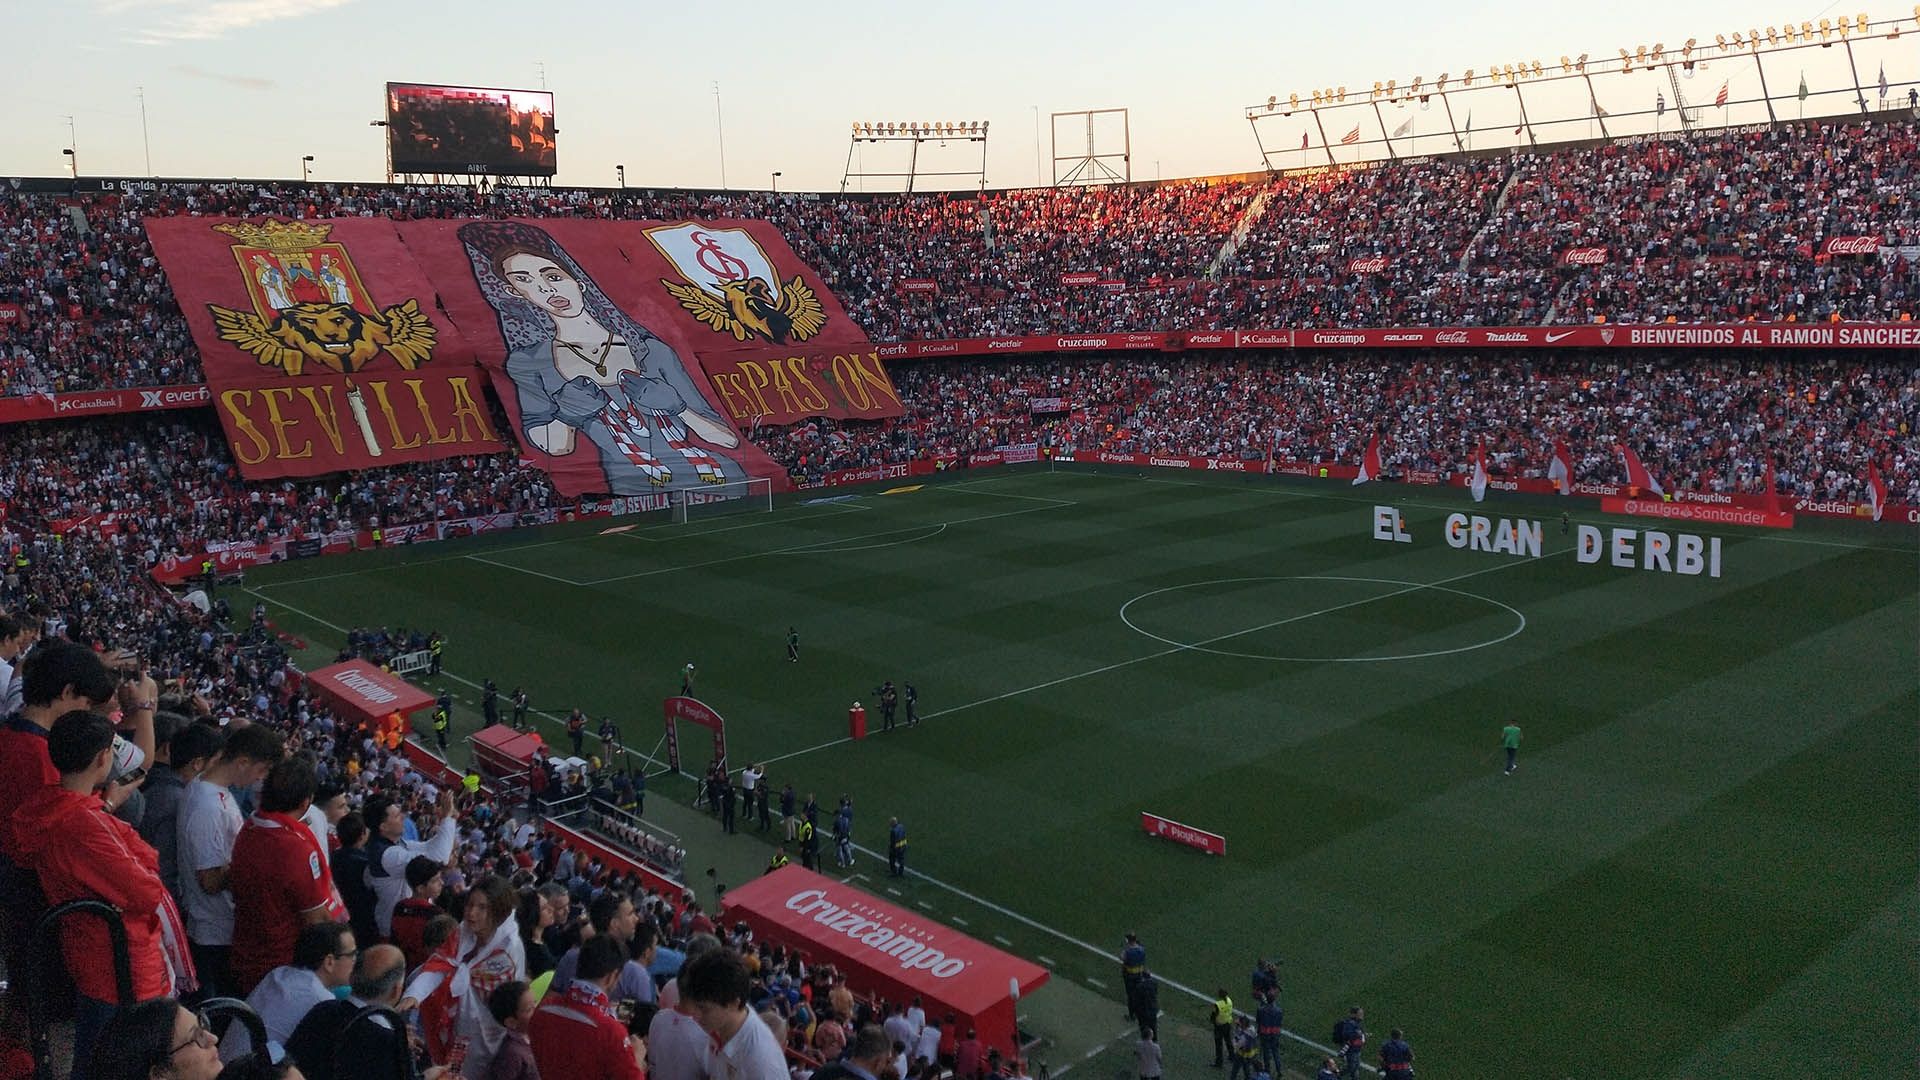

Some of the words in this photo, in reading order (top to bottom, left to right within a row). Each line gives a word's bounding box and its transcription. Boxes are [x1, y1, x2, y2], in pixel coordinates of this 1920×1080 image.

[102, 180, 114, 191] La
[1062, 275, 1097, 286] Cruzcampo
[1058, 336, 1108, 350] Cruzcampo
[1197, 334, 1223, 344] betfair
[1249, 335, 1289, 344] CaixaBank
[1313, 332, 1366, 346] Cruzcampo
[1384, 334, 1424, 342] FALKEN
[1631, 328, 1735, 345] BIENVENIDOS
[1742, 329, 1762, 345] AL
[1771, 328, 1834, 345] RAMON
[1839, 328, 1920, 345] SANCHEZ
[880, 345, 908, 356] everfx
[928, 344, 956, 353] CaixaBank
[996, 339, 1023, 349] betfair
[72, 398, 117, 409] CaixaBank
[1108, 452, 1134, 464] Playtika
[1150, 455, 1190, 470] Cruzcampo
[889, 463, 908, 478] ZTE
[1219, 460, 1245, 471] everfx
[1580, 484, 1620, 497] betfair
[627, 493, 671, 514] SEVILLA
[1687, 491, 1732, 506] Playtika
[1640, 500, 1681, 517] LaLiga
[1694, 506, 1767, 524] Santander
[1808, 500, 1856, 515] betfair
[1374, 505, 1413, 543] EL
[1446, 513, 1543, 558] GRAN
[1577, 525, 1722, 578] DERBI
[785, 889, 966, 979] Cruzcampo
